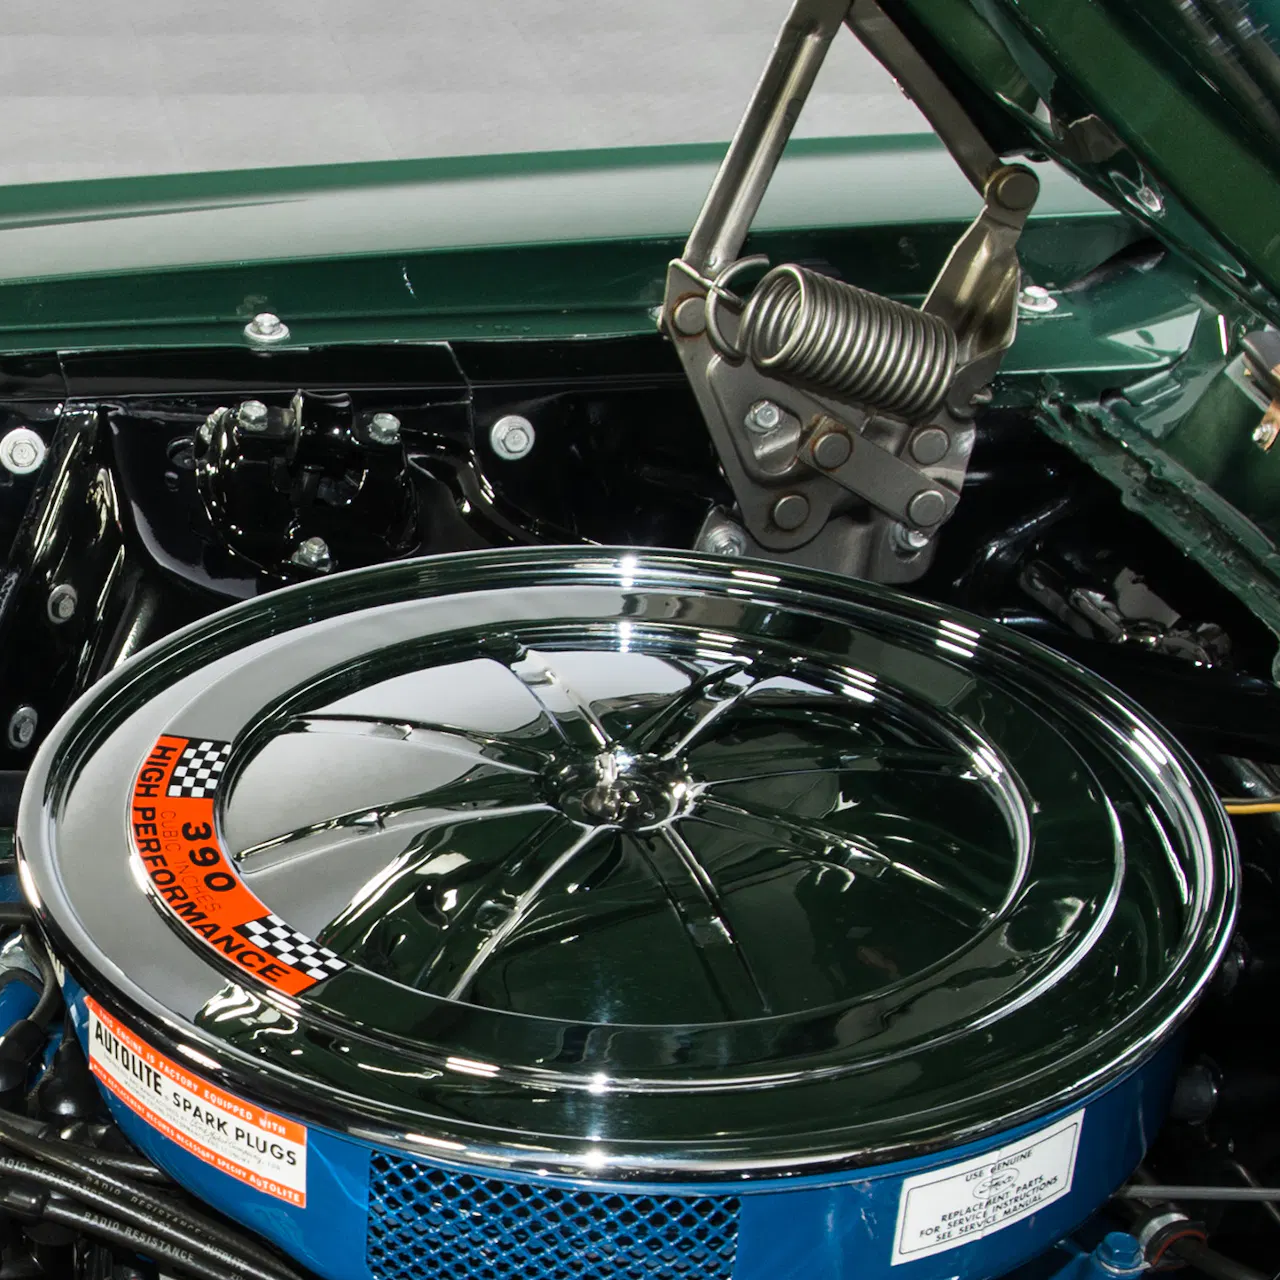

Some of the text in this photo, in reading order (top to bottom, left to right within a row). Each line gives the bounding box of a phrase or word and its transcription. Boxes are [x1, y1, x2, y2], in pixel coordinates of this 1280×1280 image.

[134, 745, 290, 983] HIGH PERFORMANCE
[160, 811, 222, 913] CUBIC INCHES
[182, 822, 237, 892] 390
[95, 1019, 297, 1166] AUTOLITE SPARK PLUGS
[116, 1027, 143, 1055] ENGINE
[146, 1053, 155, 1064] IS
[159, 1061, 198, 1092] FACTORY
[203, 1089, 253, 1120] EQUIPPED
[258, 1116, 287, 1135] WITH
[107, 1077, 145, 1113] REPLACEMENT
[146, 1112, 175, 1137] BECOMES
[176, 1133, 215, 1160] NECESSARY
[217, 1158, 247, 1178] SPECIFY
[249, 1174, 301, 1203] AUTOLITE
[965, 1149, 1033, 1182] USE GENUINE
[919, 1175, 1059, 1238] FOR SERVICE INSTRUCTIONS
[935, 1196, 1043, 1242] SEE SERVICE MANUAL
[941, 1175, 1044, 1222] REPLACEMENT PARTS
[84, 1211, 121, 1231] RADIO
[124, 1223, 196, 1264] RESISTANCE
